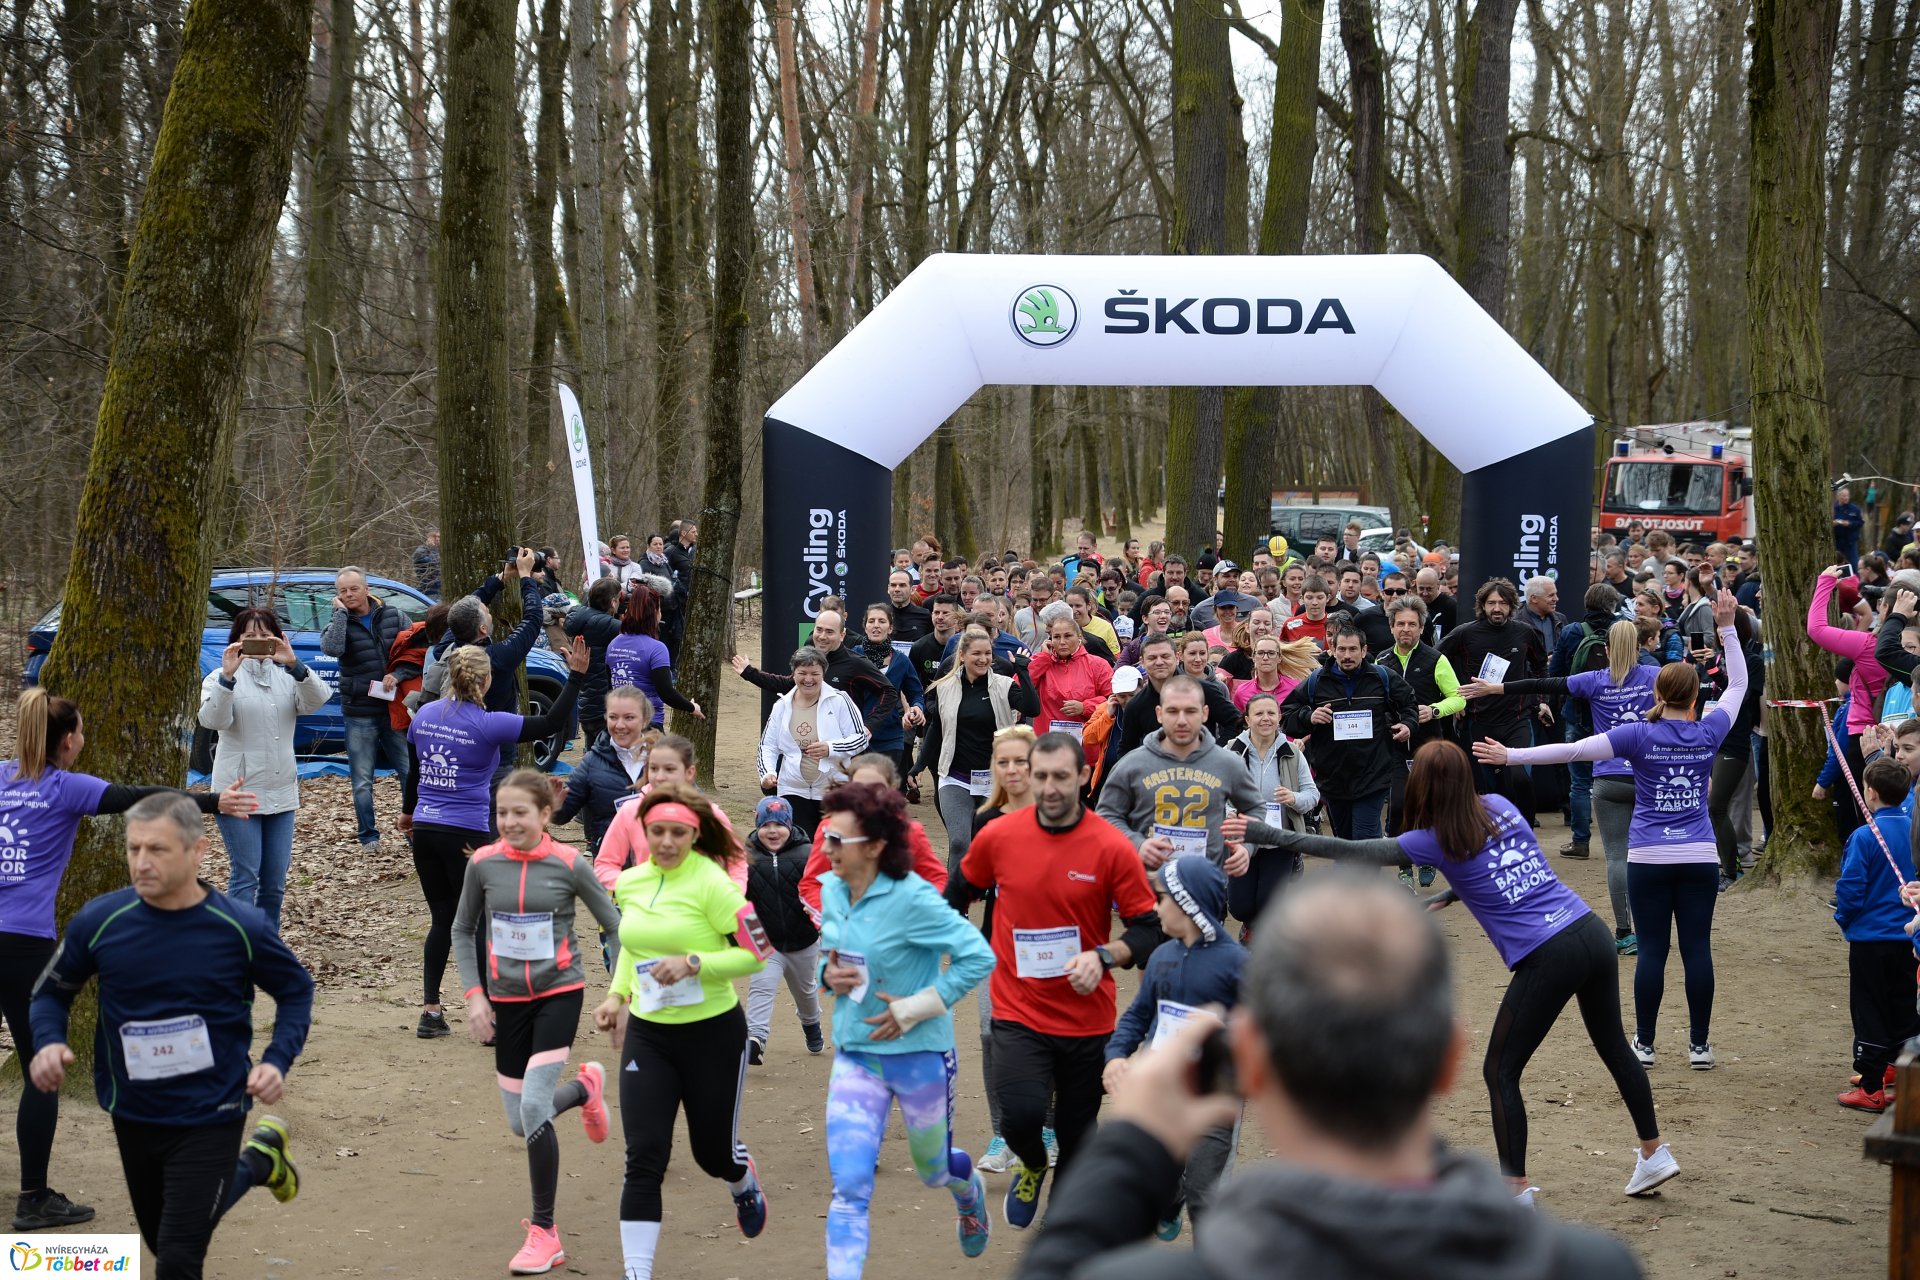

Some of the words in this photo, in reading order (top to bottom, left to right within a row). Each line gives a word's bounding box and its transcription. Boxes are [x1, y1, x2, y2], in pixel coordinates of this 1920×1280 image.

[1104, 289, 1356, 335] ŠKODA
[835, 509, 846, 558] ŠKODA
[1547, 515, 1558, 564] ŠKODA
[803, 508, 834, 619] Cycling
[1513, 514, 1546, 603] cling
[1154, 785, 1210, 828] 62
[1656, 788, 1700, 800] BÁTOR
[1494, 857, 1542, 891] BÁTOR
[1502, 870, 1549, 902] TÁBOR
[1174, 890, 1200, 914] STOP
[512, 931, 526, 940] 219
[1036, 952, 1054, 960] 302
[152, 1045, 174, 1056] 242
